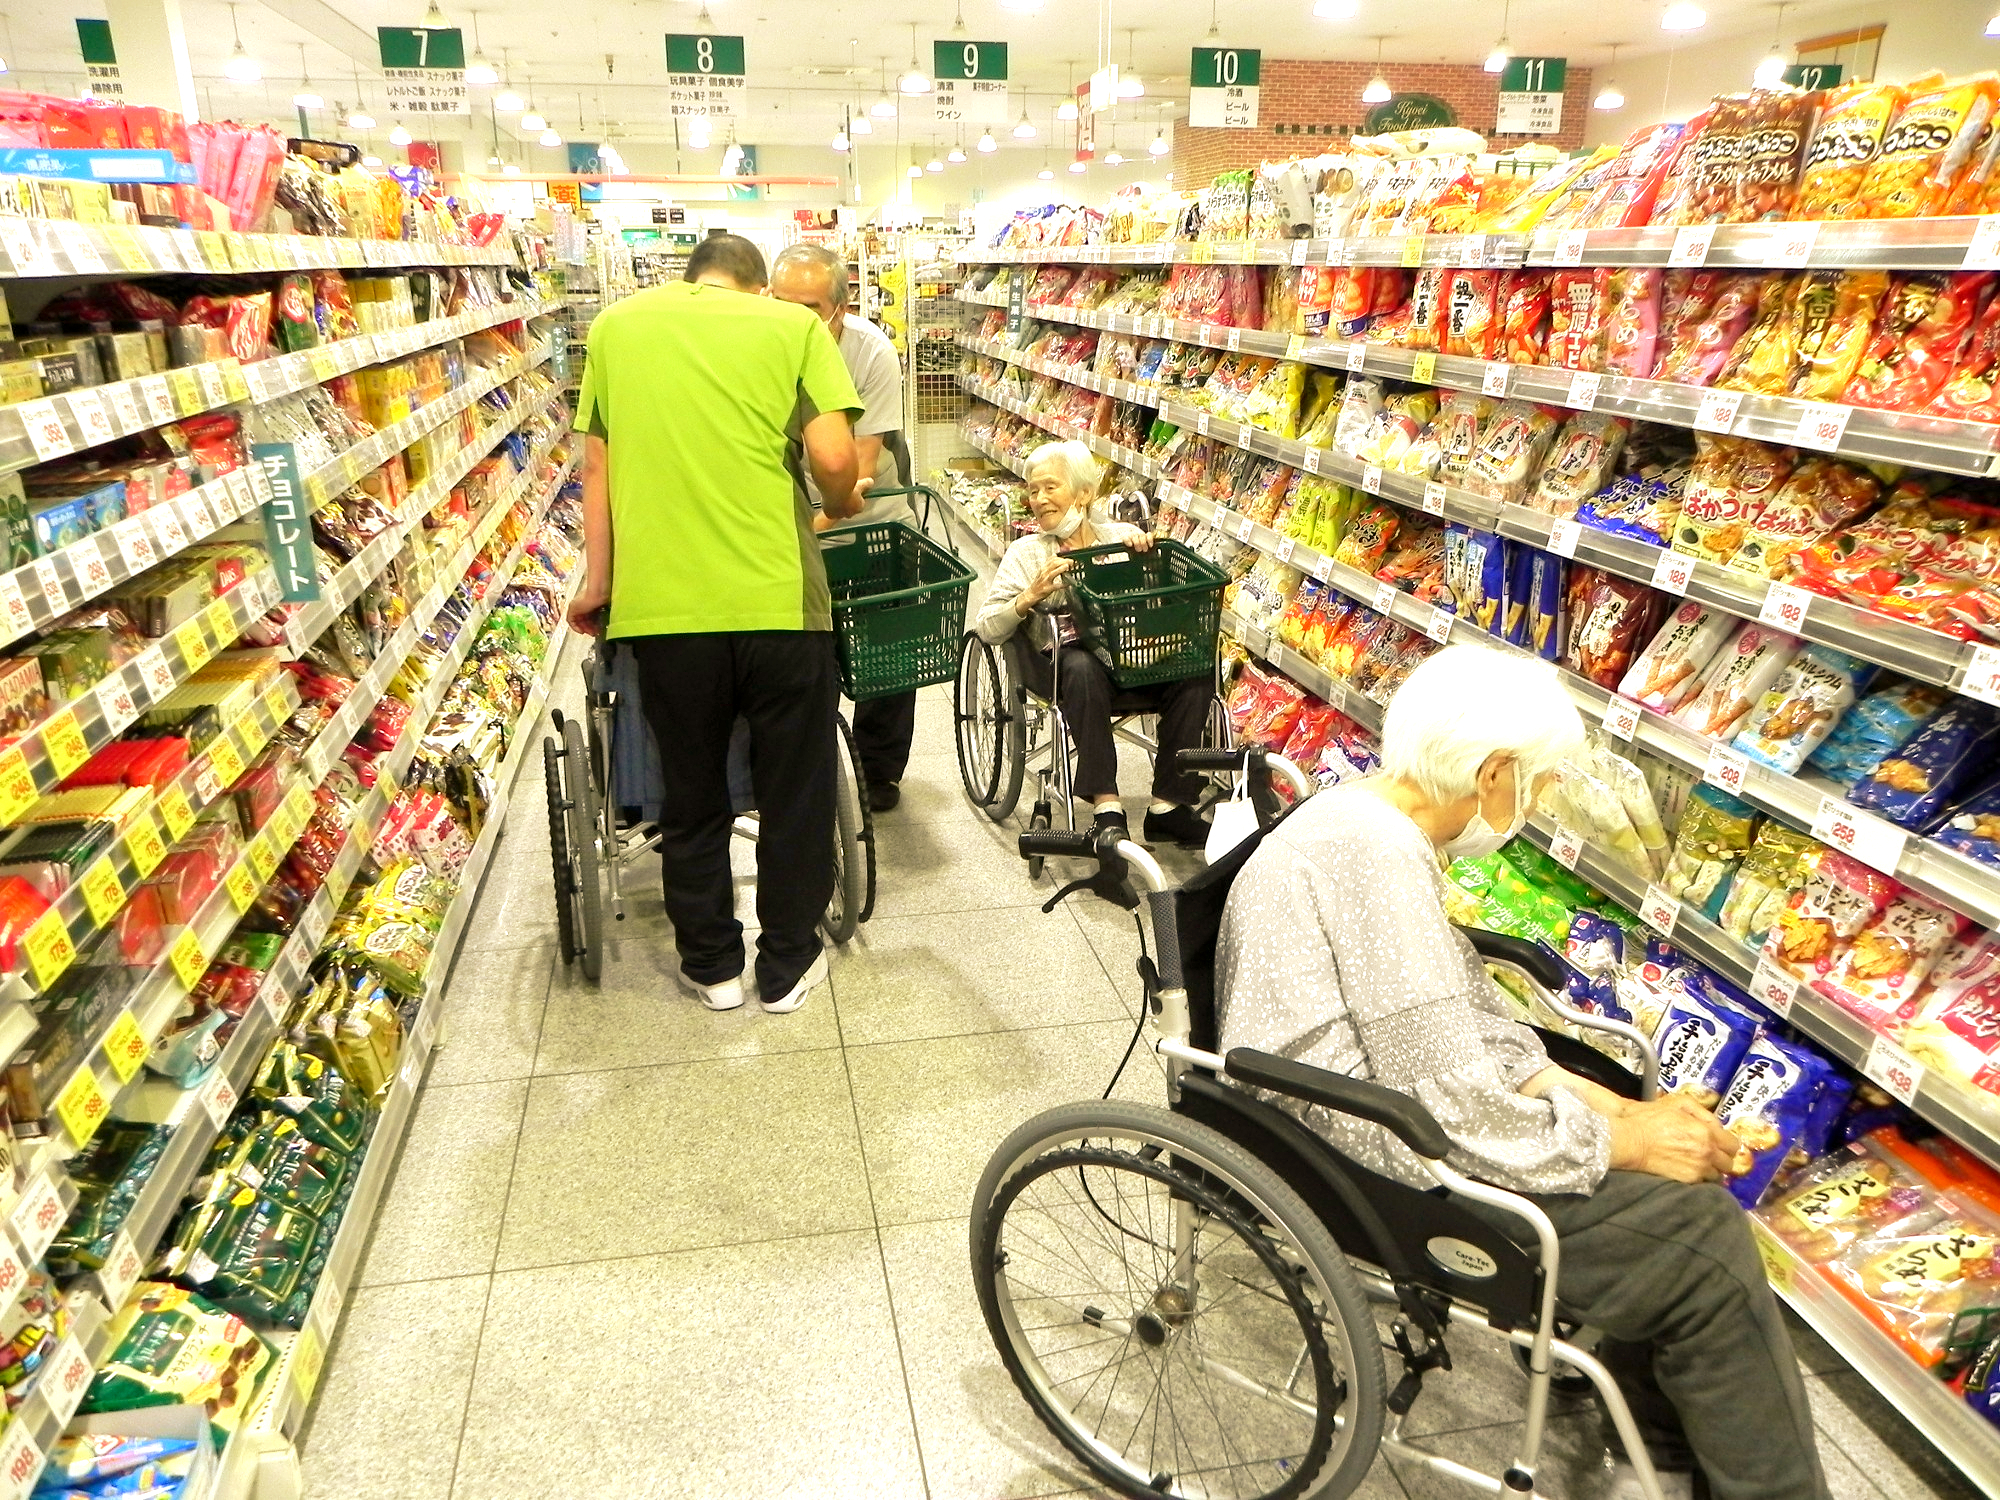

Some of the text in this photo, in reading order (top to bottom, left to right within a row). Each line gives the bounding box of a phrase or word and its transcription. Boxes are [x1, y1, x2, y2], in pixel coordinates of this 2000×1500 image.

[412, 30, 428, 66] 7
[696, 37, 714, 73] 8
[963, 43, 979, 78] 9
[1213, 50, 1238, 84] 10
[88, 67, 120, 78] 洗濯用
[427, 71, 464, 81] スナック菓子
[1524, 59, 1545, 91] 11
[1800, 67, 1823, 90] 12
[92, 83, 123, 94] 掃除用
[386, 86, 466, 96] レトルトご飯 スナック菓子
[670, 76, 744, 88] 玩具菓子 個食美学
[936, 81, 954, 91] 清酒
[670, 90, 706, 101] ポケット菓子
[937, 95, 954, 105] 焼酎
[1227, 88, 1243, 97] 冷酒
[390, 101, 459, 112] 米・雑穀 駄菓子
[671, 105, 707, 115] 箱スナック
[936, 110, 961, 119] ワイン
[1226, 102, 1249, 111] ビール
[1394, 101, 1428, 119] Kyoei
[1225, 116, 1248, 125] ビール
[1377, 117, 1409, 131] Food
[552, 185, 576, 203] 薬
[1687, 243, 1705, 256] 218
[1010, 277, 1022, 330] 半生菓子
[1450, 280, 1474, 333] 揚一番
[1567, 280, 1594, 368] 無限エビ
[1816, 422, 1838, 439] 188
[1683, 488, 1767, 521] ばかうけ
[263, 454, 310, 592] チョコレート
[1669, 568, 1686, 585] 188
[1780, 602, 1801, 621] 188
[1792, 655, 1843, 691] カルシウム
[1617, 714, 1633, 731] 228
[1720, 769, 1740, 785] 208
[1831, 822, 1856, 843] 258
[1810, 876, 1865, 911] アーモンド
[1812, 895, 1837, 917] せん
[1889, 896, 1943, 922] アーモンド
[1653, 908, 1672, 926] 258
[48, 937, 68, 963] 178
[1766, 984, 1788, 1004] 208
[1887, 1066, 1912, 1092] 438
[1455, 1250, 1490, 1268] Care-Tec
[1462, 1259, 1484, 1272] Japan
[9, 1448, 36, 1483] 198
